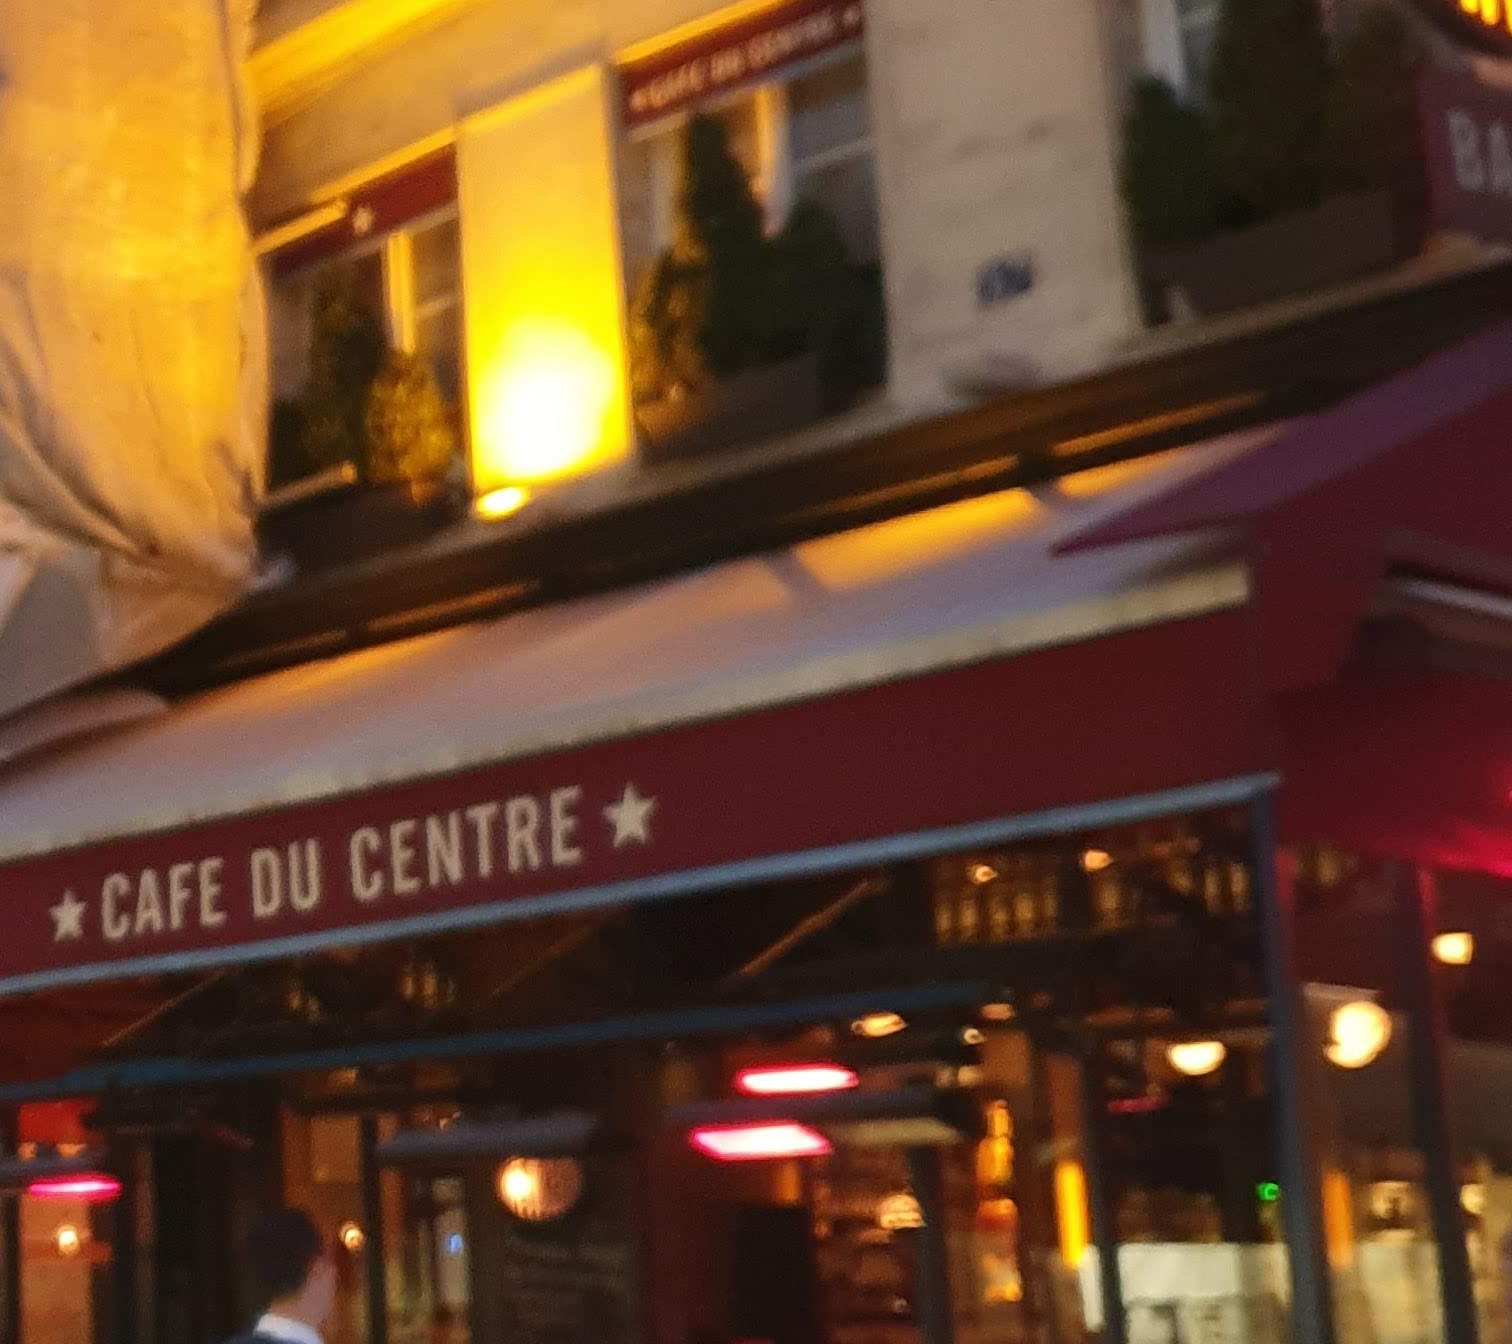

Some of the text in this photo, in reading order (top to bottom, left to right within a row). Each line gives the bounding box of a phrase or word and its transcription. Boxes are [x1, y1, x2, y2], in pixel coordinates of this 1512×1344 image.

[99, 785, 584, 943] CAFE DU CENTRE
